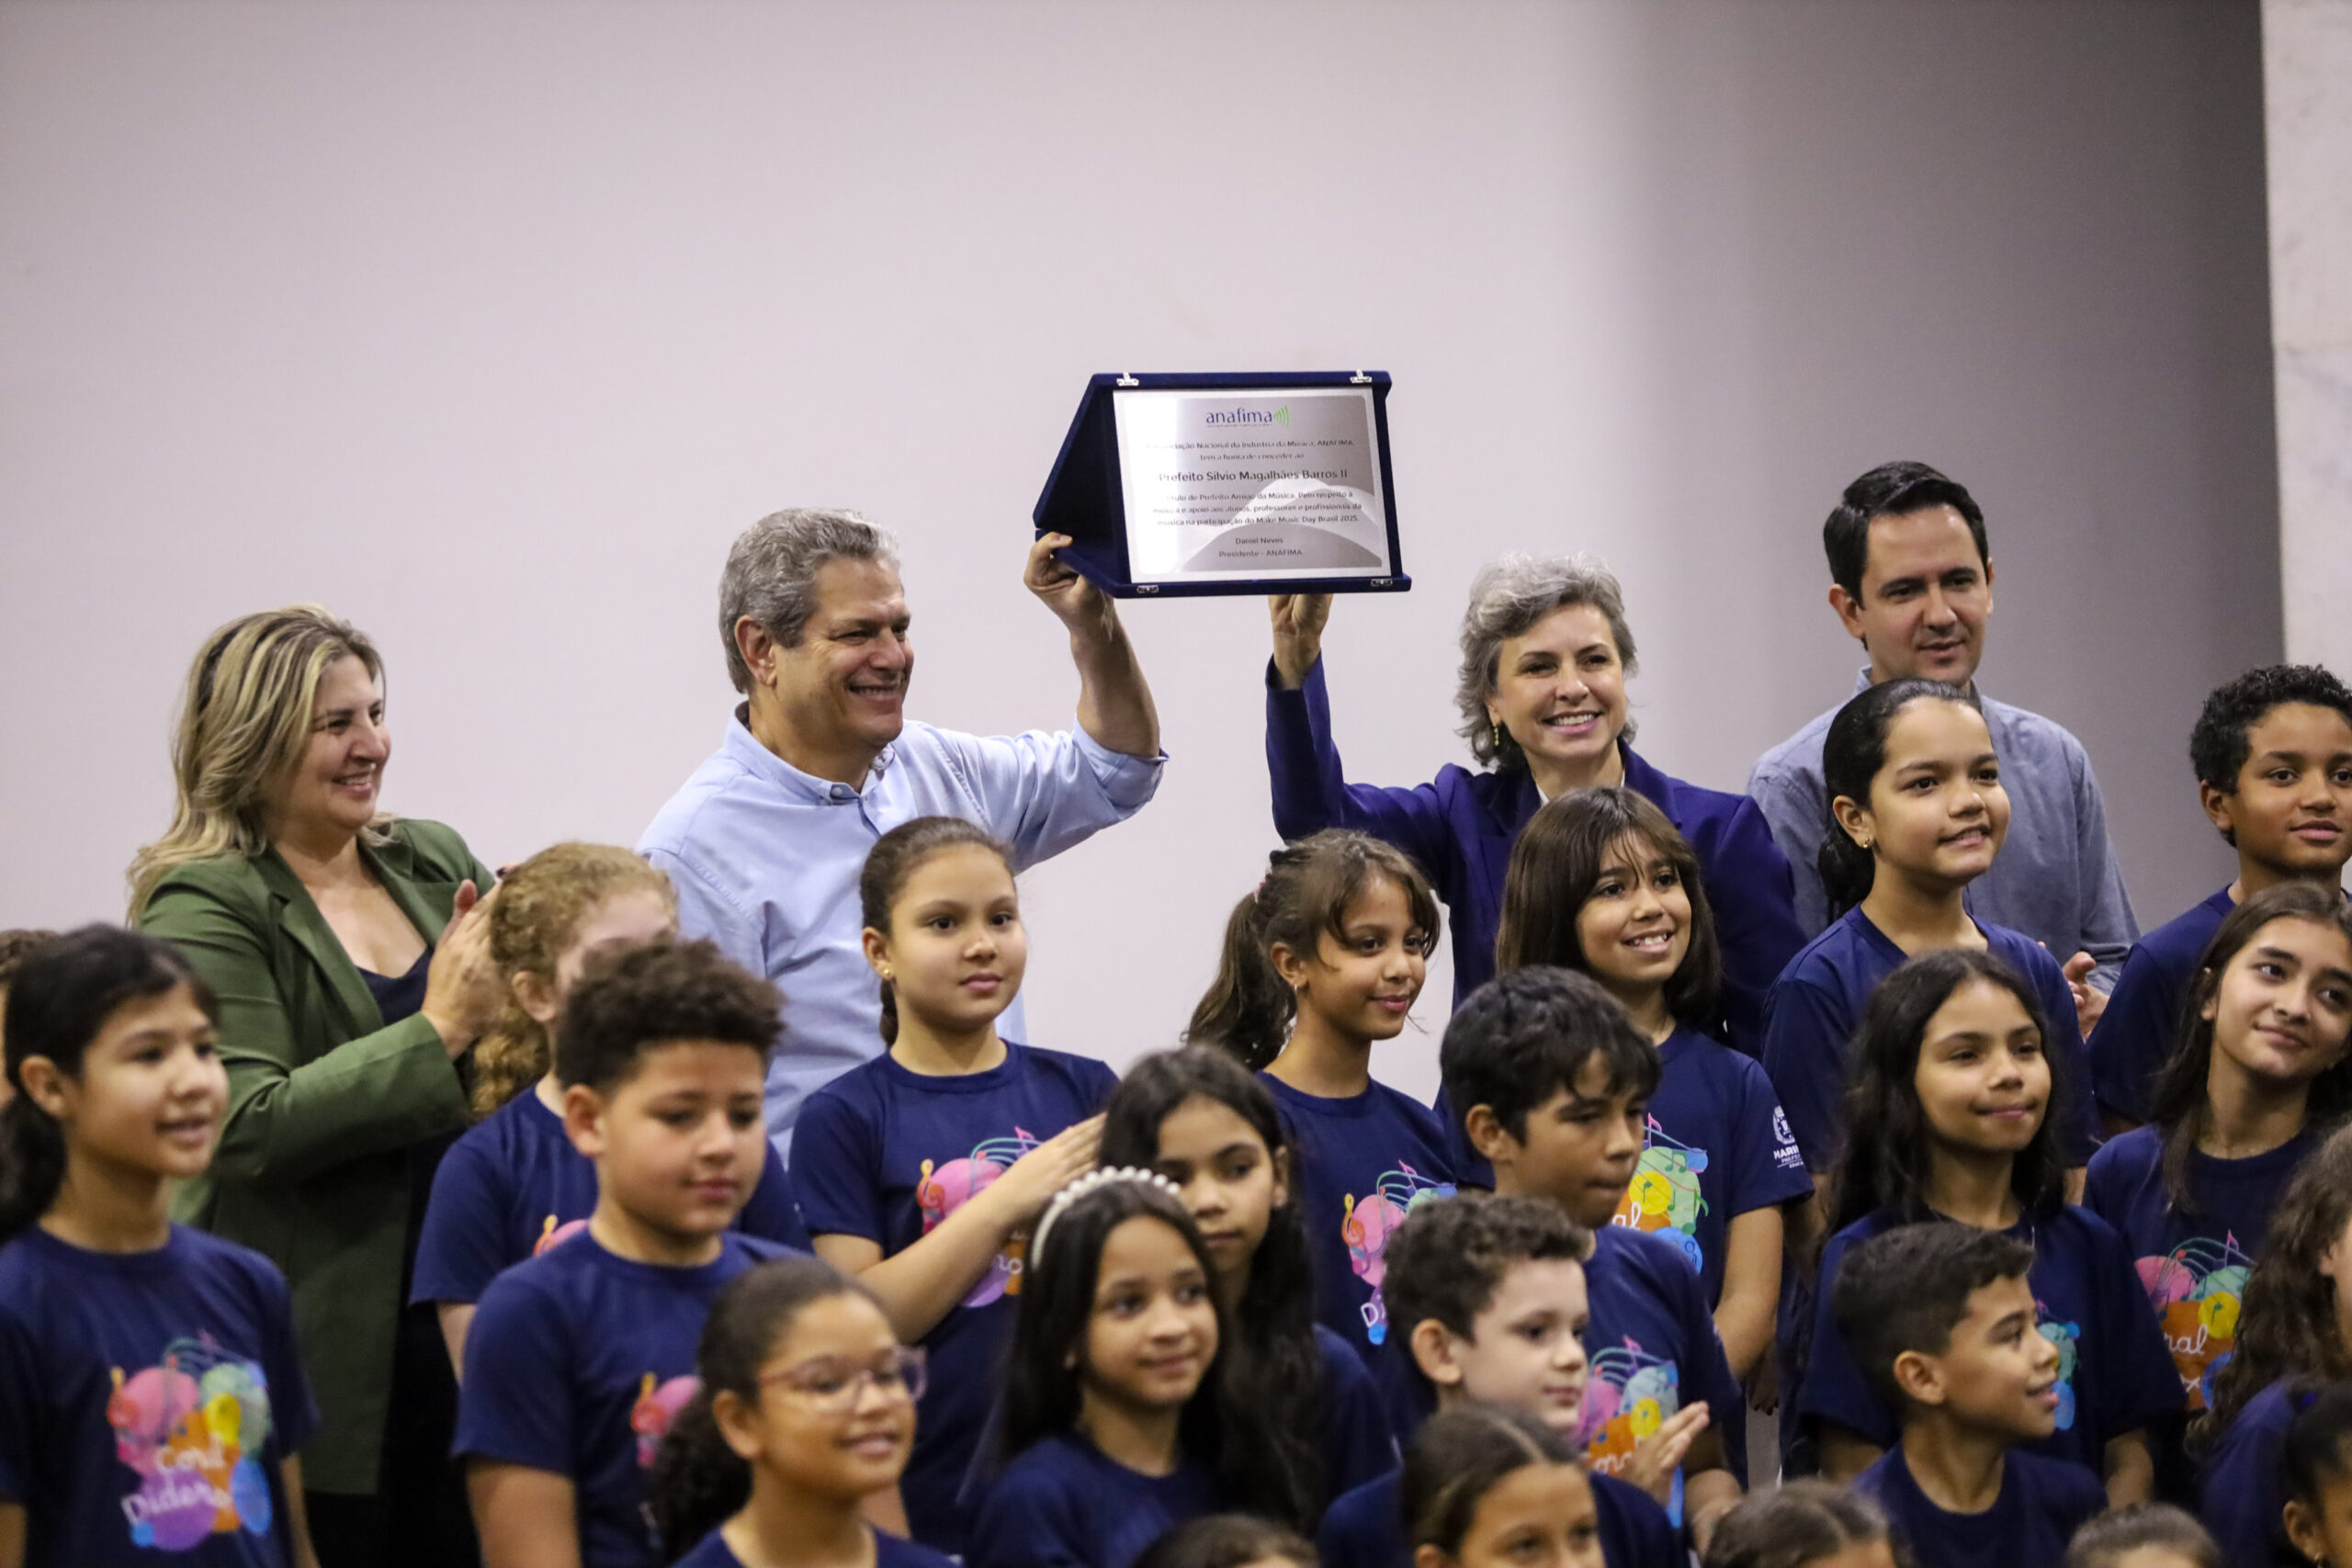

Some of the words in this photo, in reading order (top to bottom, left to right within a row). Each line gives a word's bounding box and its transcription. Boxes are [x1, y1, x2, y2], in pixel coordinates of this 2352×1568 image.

[1205, 406, 1273, 423] anafima
[1159, 471, 1204, 482] Prefeito
[1206, 470, 1237, 481] Silvio
[1239, 470, 1299, 482] Magalhães
[1302, 469, 1338, 479] Barros
[1340, 468, 1348, 479] II
[1316, 491, 1347, 500] respeito
[1253, 504, 1297, 513] professores
[1305, 503, 1351, 513] profissionais
[1196, 517, 1243, 527] participação
[1256, 515, 1277, 524] Make
[1278, 515, 1300, 524] Music
[1302, 514, 1317, 525] Day
[1317, 513, 1340, 523] Brasil
[1235, 536, 1259, 545] Daniel
[1218, 549, 1260, 558] Presidente
[1266, 548, 1303, 557] ANAFIMA
[2164, 1324, 2206, 1356] ral
